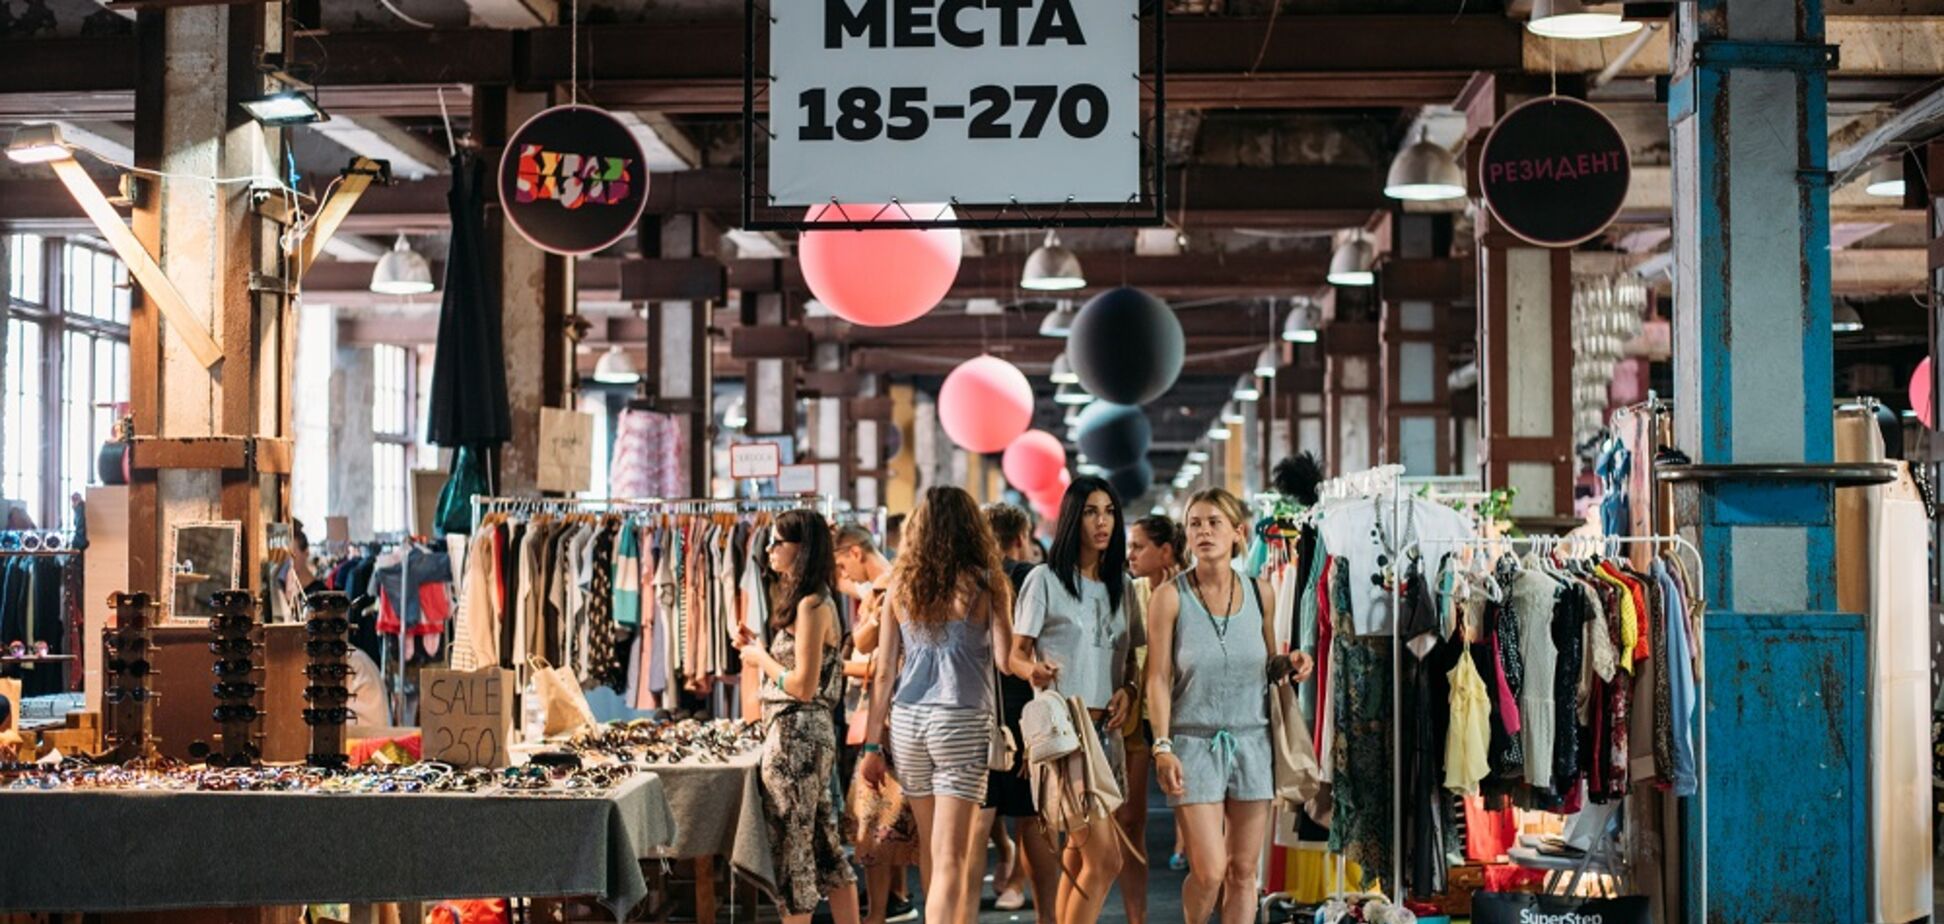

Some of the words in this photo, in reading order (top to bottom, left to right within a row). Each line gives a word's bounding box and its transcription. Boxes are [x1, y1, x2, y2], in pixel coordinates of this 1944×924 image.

[825, 0, 1086, 48] МЕСТА
[798, 83, 1109, 142] 185-270
[1489, 151, 1621, 184] РЕЗИДЕНТ
[429, 677, 501, 716] SALE
[436, 726, 497, 769] 250
